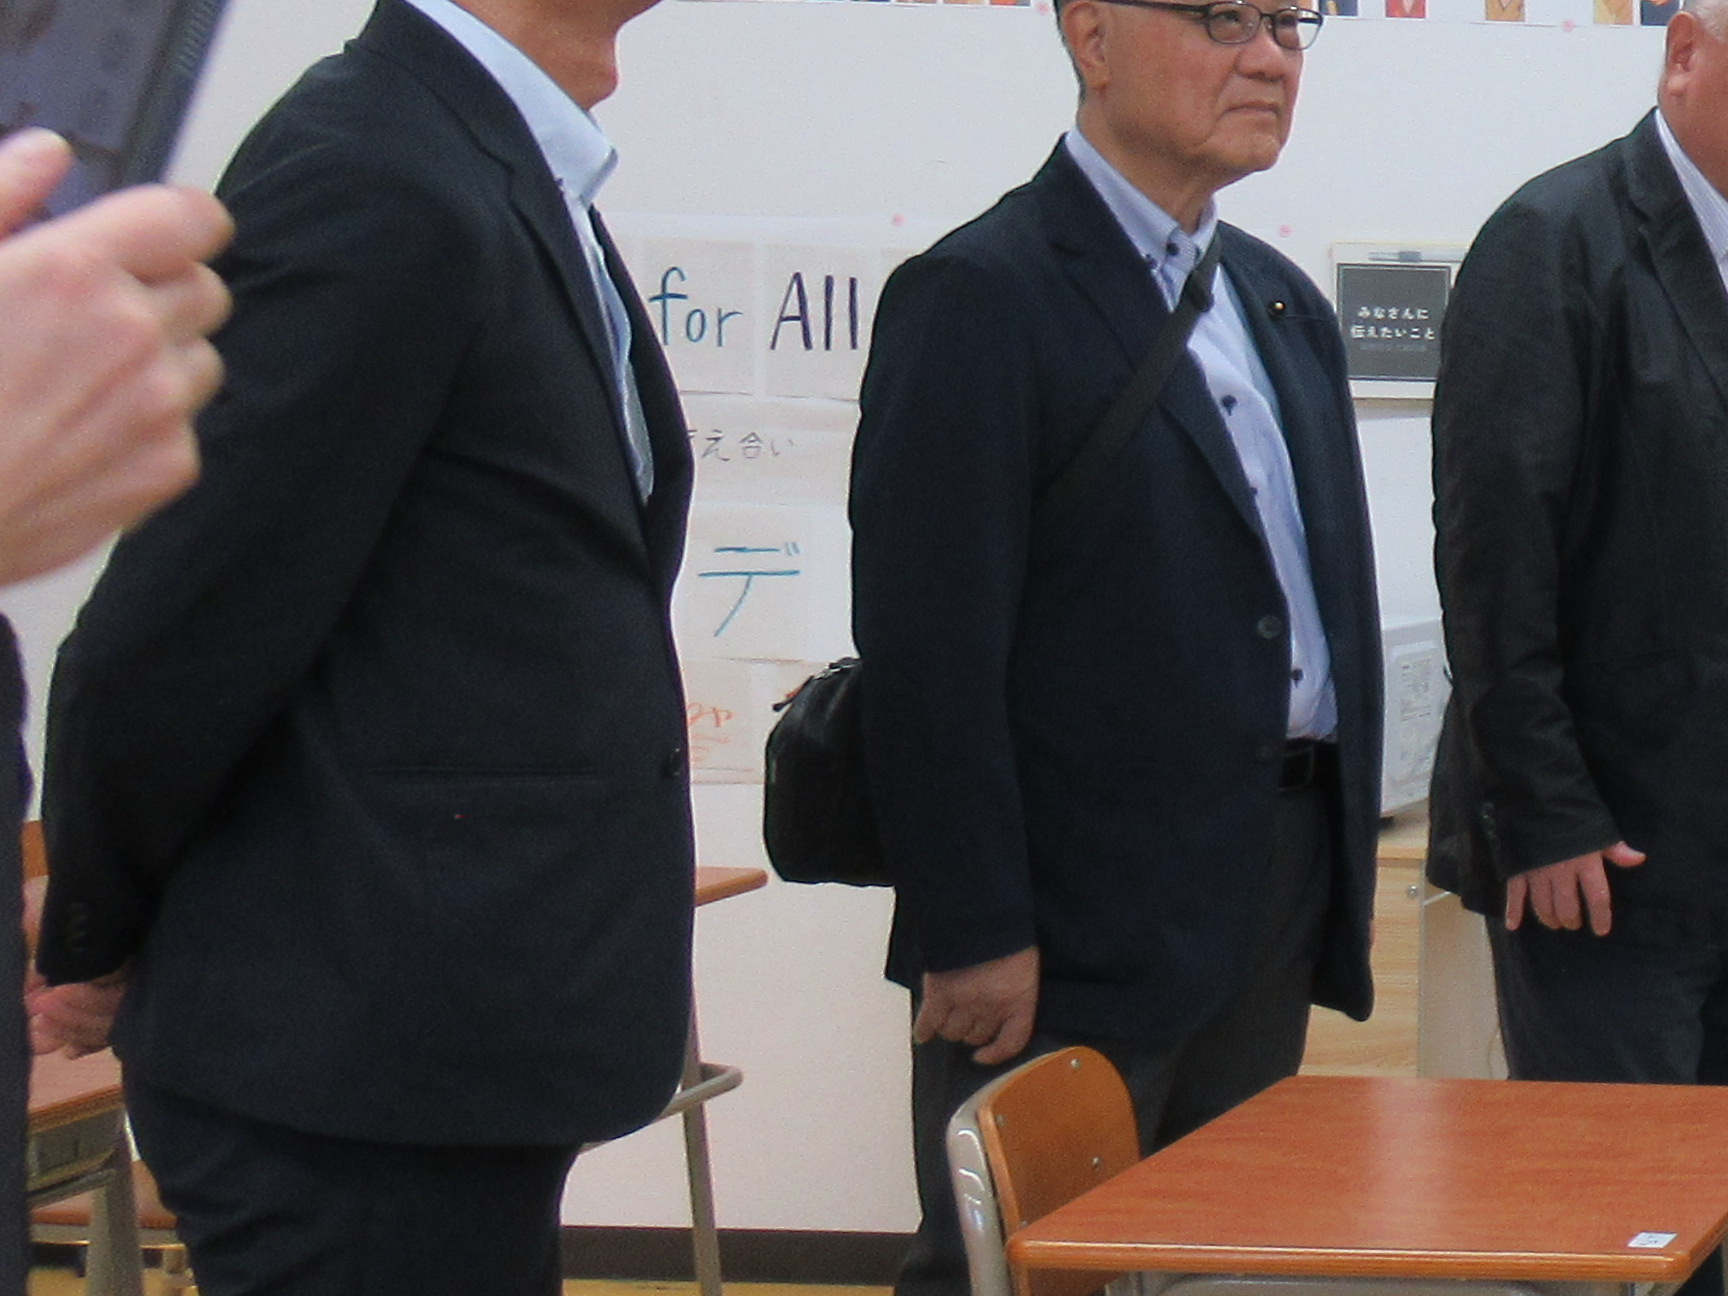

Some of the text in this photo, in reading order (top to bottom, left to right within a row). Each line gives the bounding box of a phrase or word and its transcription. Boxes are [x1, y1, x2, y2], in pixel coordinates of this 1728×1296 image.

[649, 266, 861, 352] for All
[1350, 324, 1436, 340] 伝えたいこと
[1357, 306, 1430, 321] みなさんに
[697, 541, 801, 638] デ
